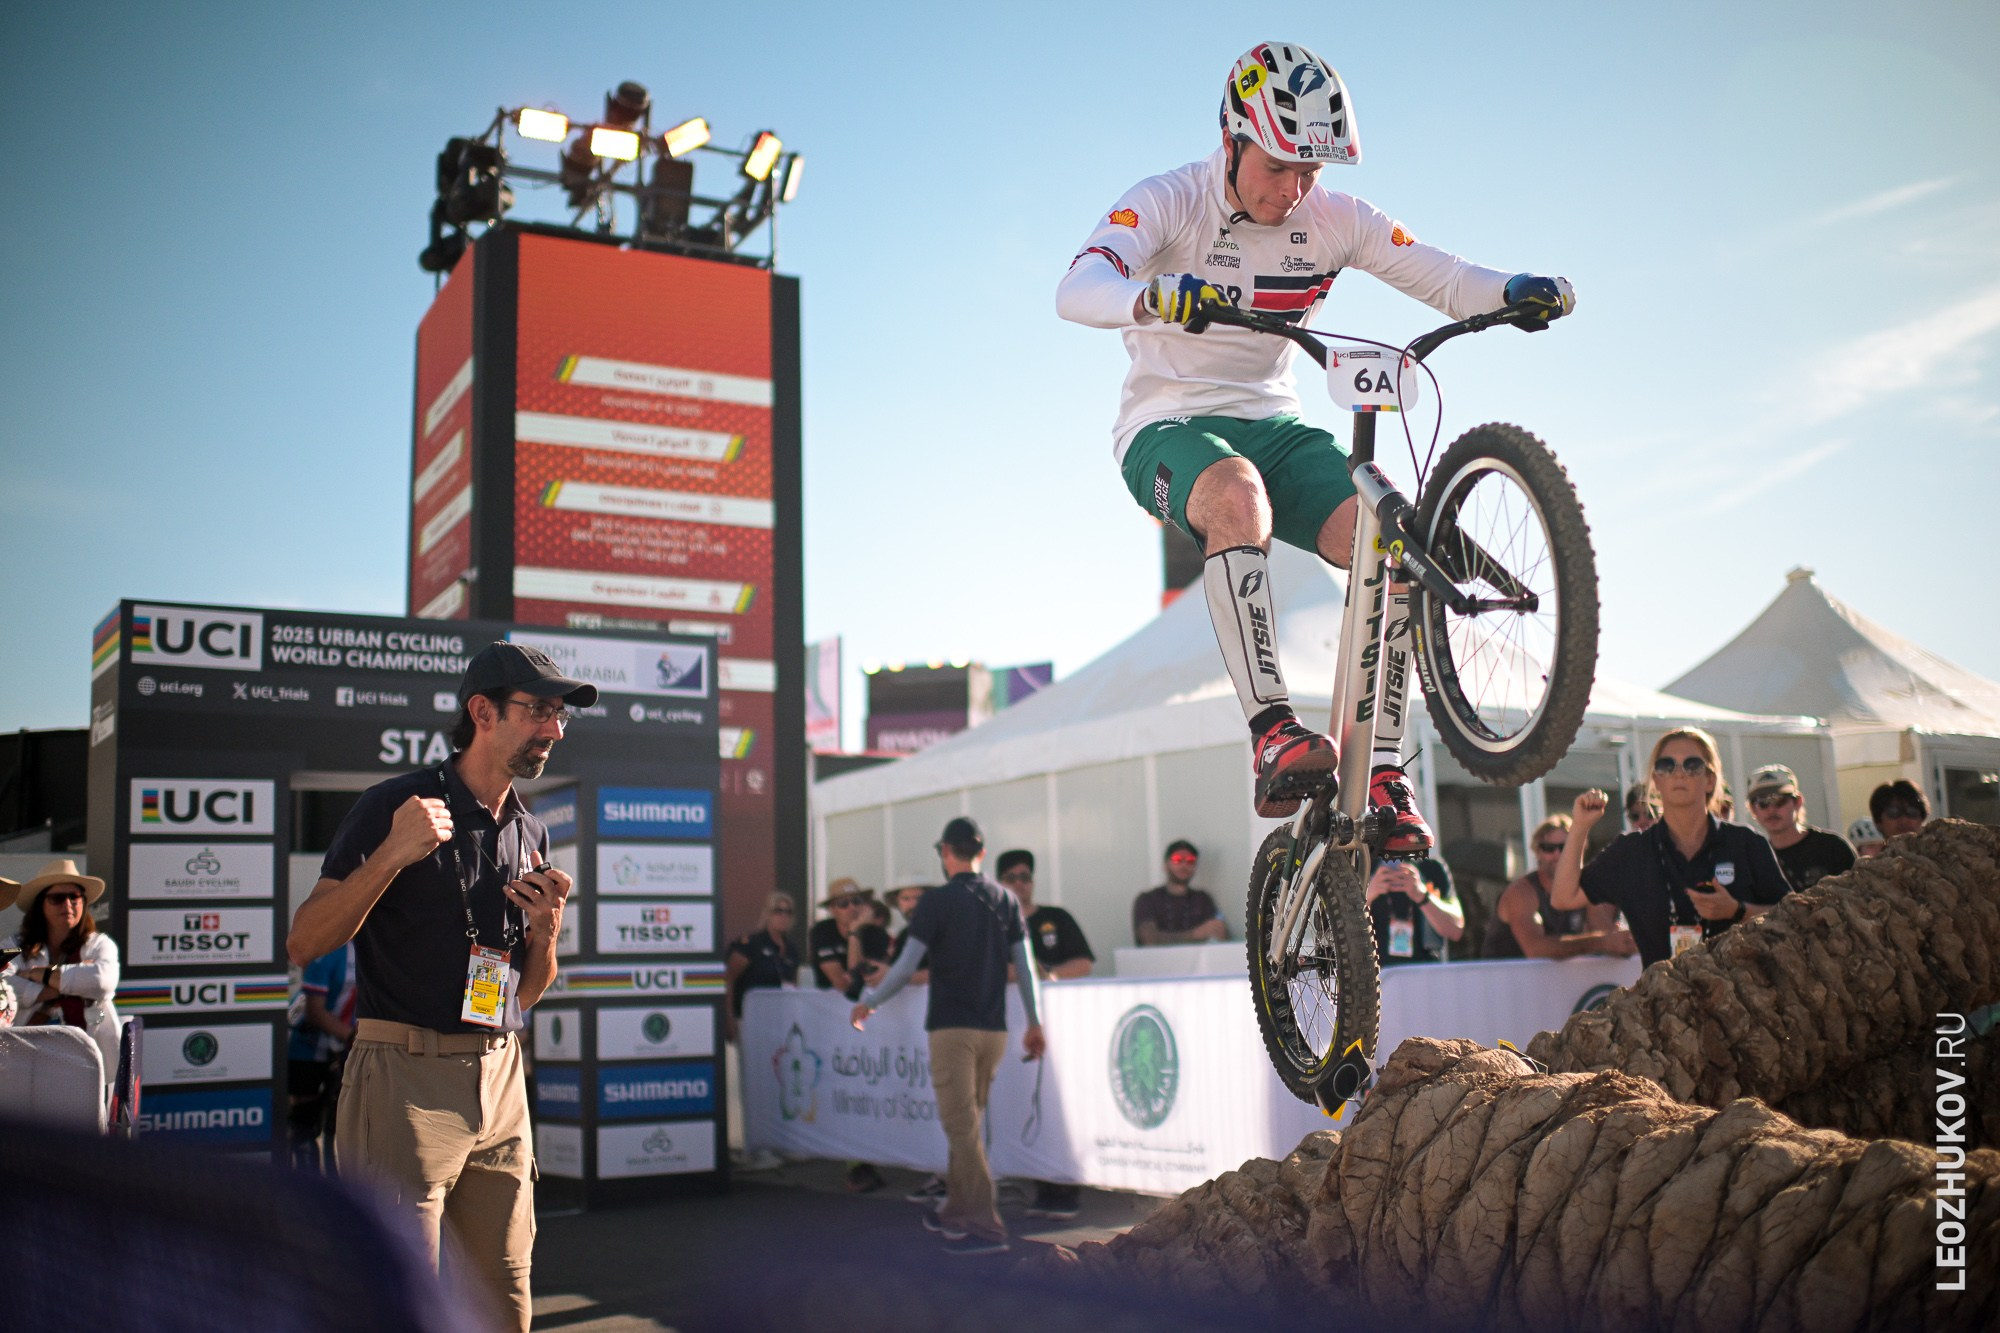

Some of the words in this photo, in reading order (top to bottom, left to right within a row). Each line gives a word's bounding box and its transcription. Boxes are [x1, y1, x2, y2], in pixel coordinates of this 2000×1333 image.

[1212, 260, 1240, 269] CYCLING
[1213, 254, 1241, 263] BRITISH
[1354, 367, 1395, 394] 6A
[156, 618, 251, 659] UCI
[271, 624, 315, 644] 2025
[318, 627, 381, 649] URBAN
[385, 631, 463, 654] CYCLING
[1247, 602, 1282, 685] JITSIE
[1355, 558, 1386, 723] JITSIE
[271, 645, 341, 665] WORLD
[571, 667, 627, 683] ARABIA
[160, 681, 203, 697] uci.org
[1383, 645, 1406, 728] JITSIE
[379, 729, 462, 765] STA
[163, 788, 254, 824] UCI
[603, 801, 706, 823] SHIMANO
[152, 932, 250, 952] TISSOT
[616, 925, 694, 942] TISSOT
[482, 960, 497, 968] 2025
[634, 969, 677, 990] UCI
[174, 983, 227, 1005] UCI
[604, 1078, 708, 1104] SHIMANO
[139, 1106, 264, 1132] SHIMANO
